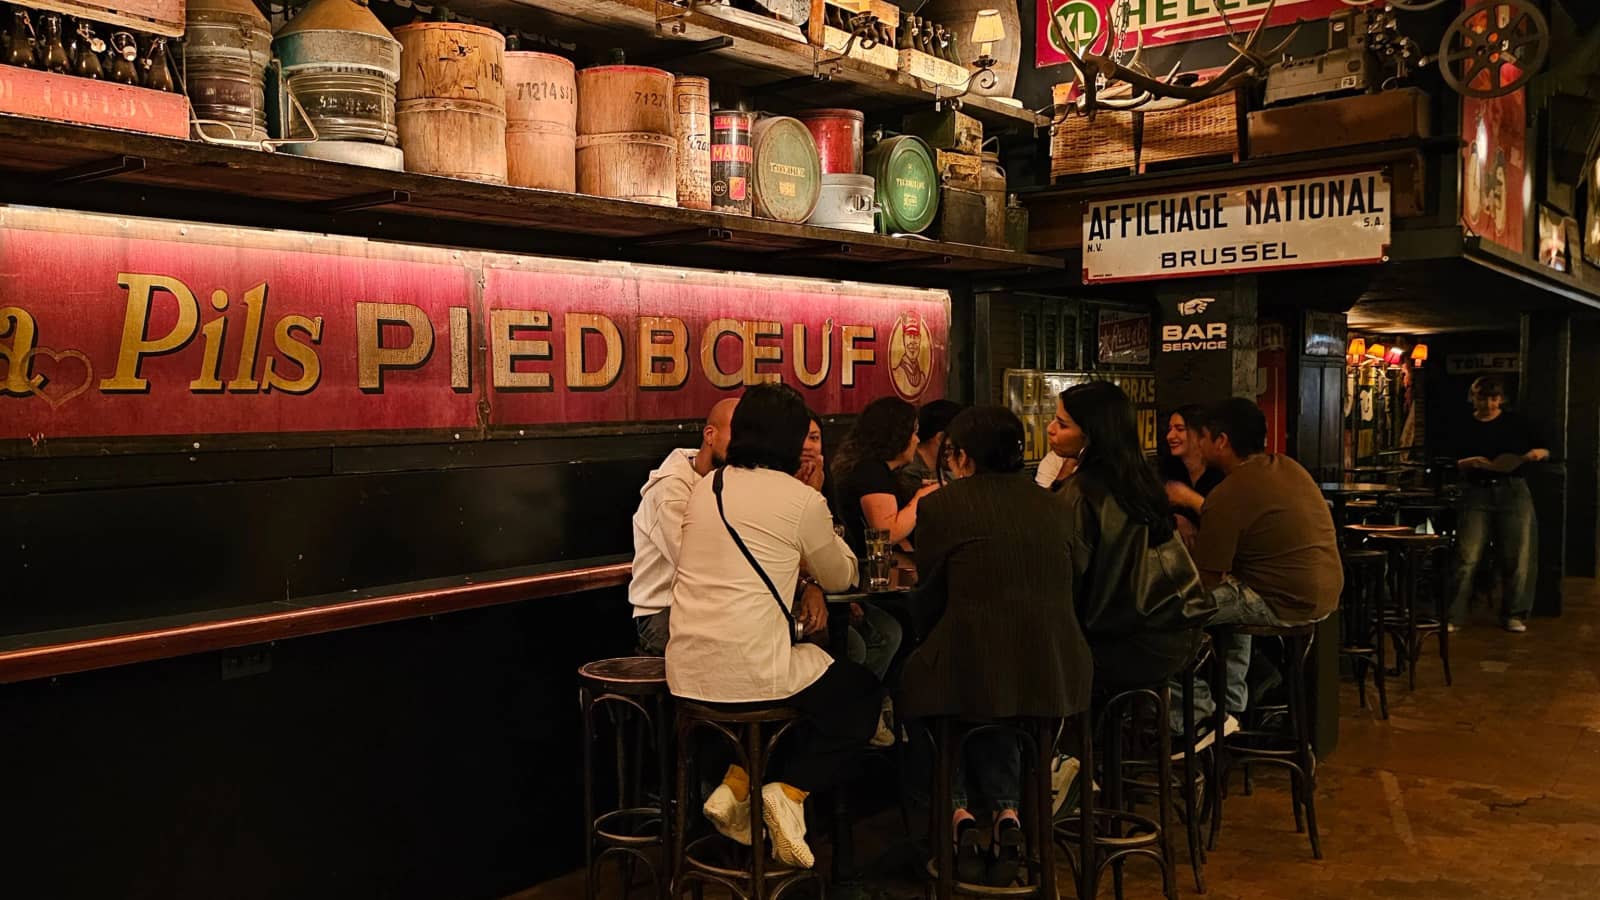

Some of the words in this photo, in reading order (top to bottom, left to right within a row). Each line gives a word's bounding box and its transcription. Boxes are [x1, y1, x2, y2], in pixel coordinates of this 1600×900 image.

[1056, 11, 1092, 42] XL
[1088, 193, 1228, 241] AFFICHAGE
[1245, 176, 1384, 226] NATIONAL
[1364, 217, 1385, 228] S.A.
[1087, 243, 1103, 253] N.V.
[1161, 243, 1298, 269] BRUSSEL
[100, 271, 324, 395] Pils
[1162, 322, 1228, 341] BAR
[1162, 341, 1228, 353] SERVICE
[1452, 357, 1518, 369] TOILET
